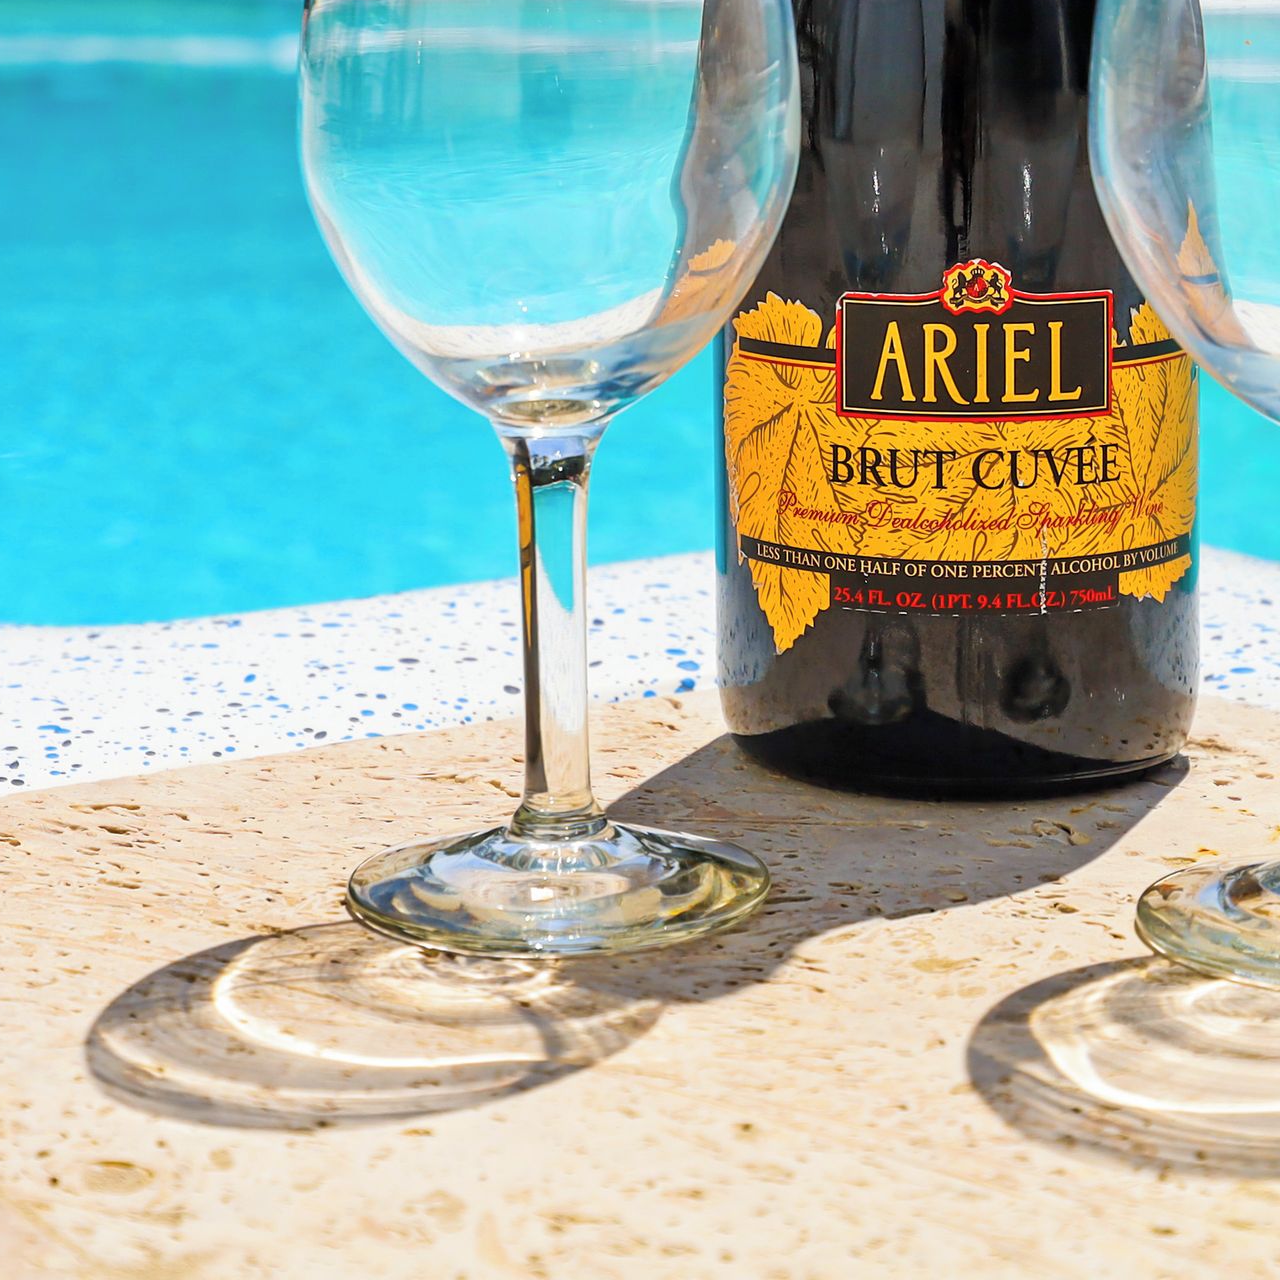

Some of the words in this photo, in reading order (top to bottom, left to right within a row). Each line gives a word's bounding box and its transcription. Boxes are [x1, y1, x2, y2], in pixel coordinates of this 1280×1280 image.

[870, 320, 1082, 405] ARIEL
[828, 443, 956, 490] BRUT
[971, 435, 1121, 490] CUVÉE
[776, 488, 860, 525] Premium
[866, 499, 1016, 532] Dealcoholized
[1016, 499, 1121, 538] Sparkling
[1123, 491, 1164, 520] Wine
[756, 542, 780, 561] LESS
[783, 549, 821, 568] THAN
[824, 556, 857, 573] ONE
[860, 559, 901, 576] HALF
[904, 563, 928, 578] OF
[930, 564, 969, 579] ONE
[972, 562, 1047, 579] PERCENT
[1051, 556, 1121, 576] ALCOHOL
[1123, 551, 1139, 567] BY
[1139, 542, 1179, 564] VOLUME
[833, 586, 864, 604] 25.4
[868, 589, 892, 607] FL.
[895, 591, 927, 609] OZ.
[931, 592, 973, 611] (1PT.
[976, 593, 1002, 609] 9.4
[1070, 585, 1117, 606] 750mL
